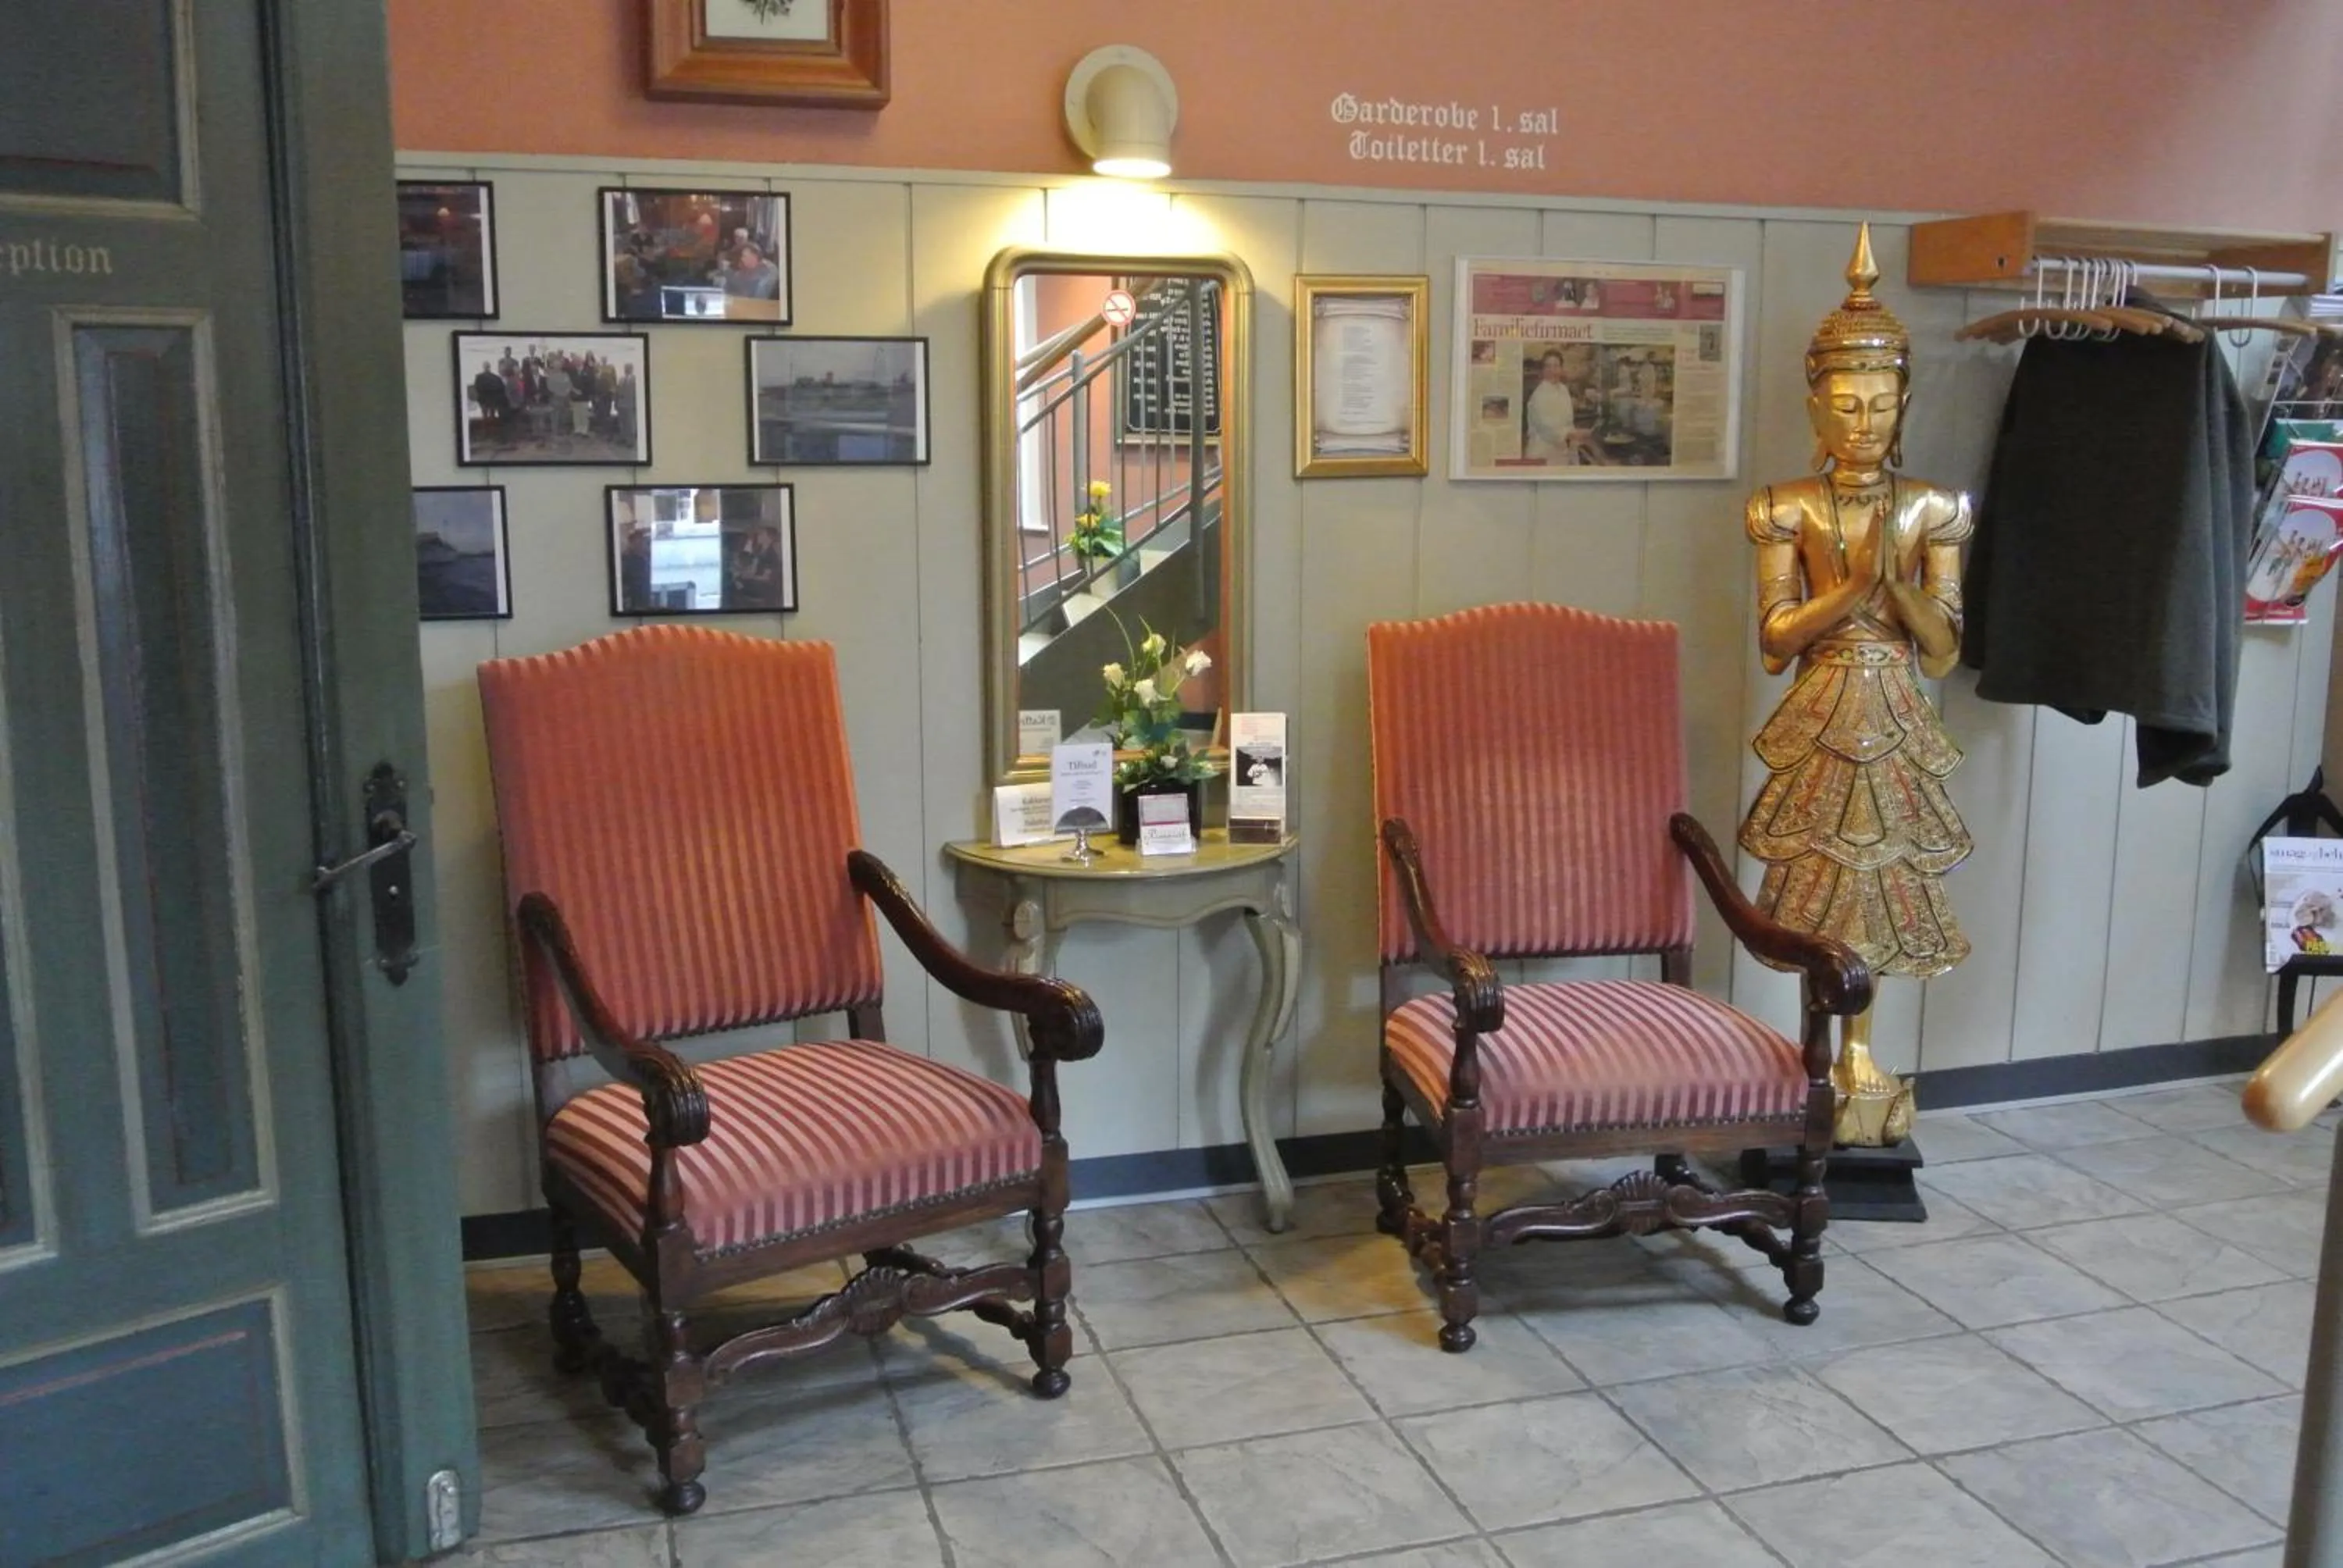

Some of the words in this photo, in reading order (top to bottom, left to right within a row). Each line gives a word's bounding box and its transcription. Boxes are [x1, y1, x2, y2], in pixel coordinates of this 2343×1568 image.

[1330, 91, 1479, 131] Garderobe
[1518, 107, 1560, 135] sal
[1348, 129, 1469, 165] Toiletter
[1503, 144, 1546, 170] sal
[0, 237, 113, 276] ption
